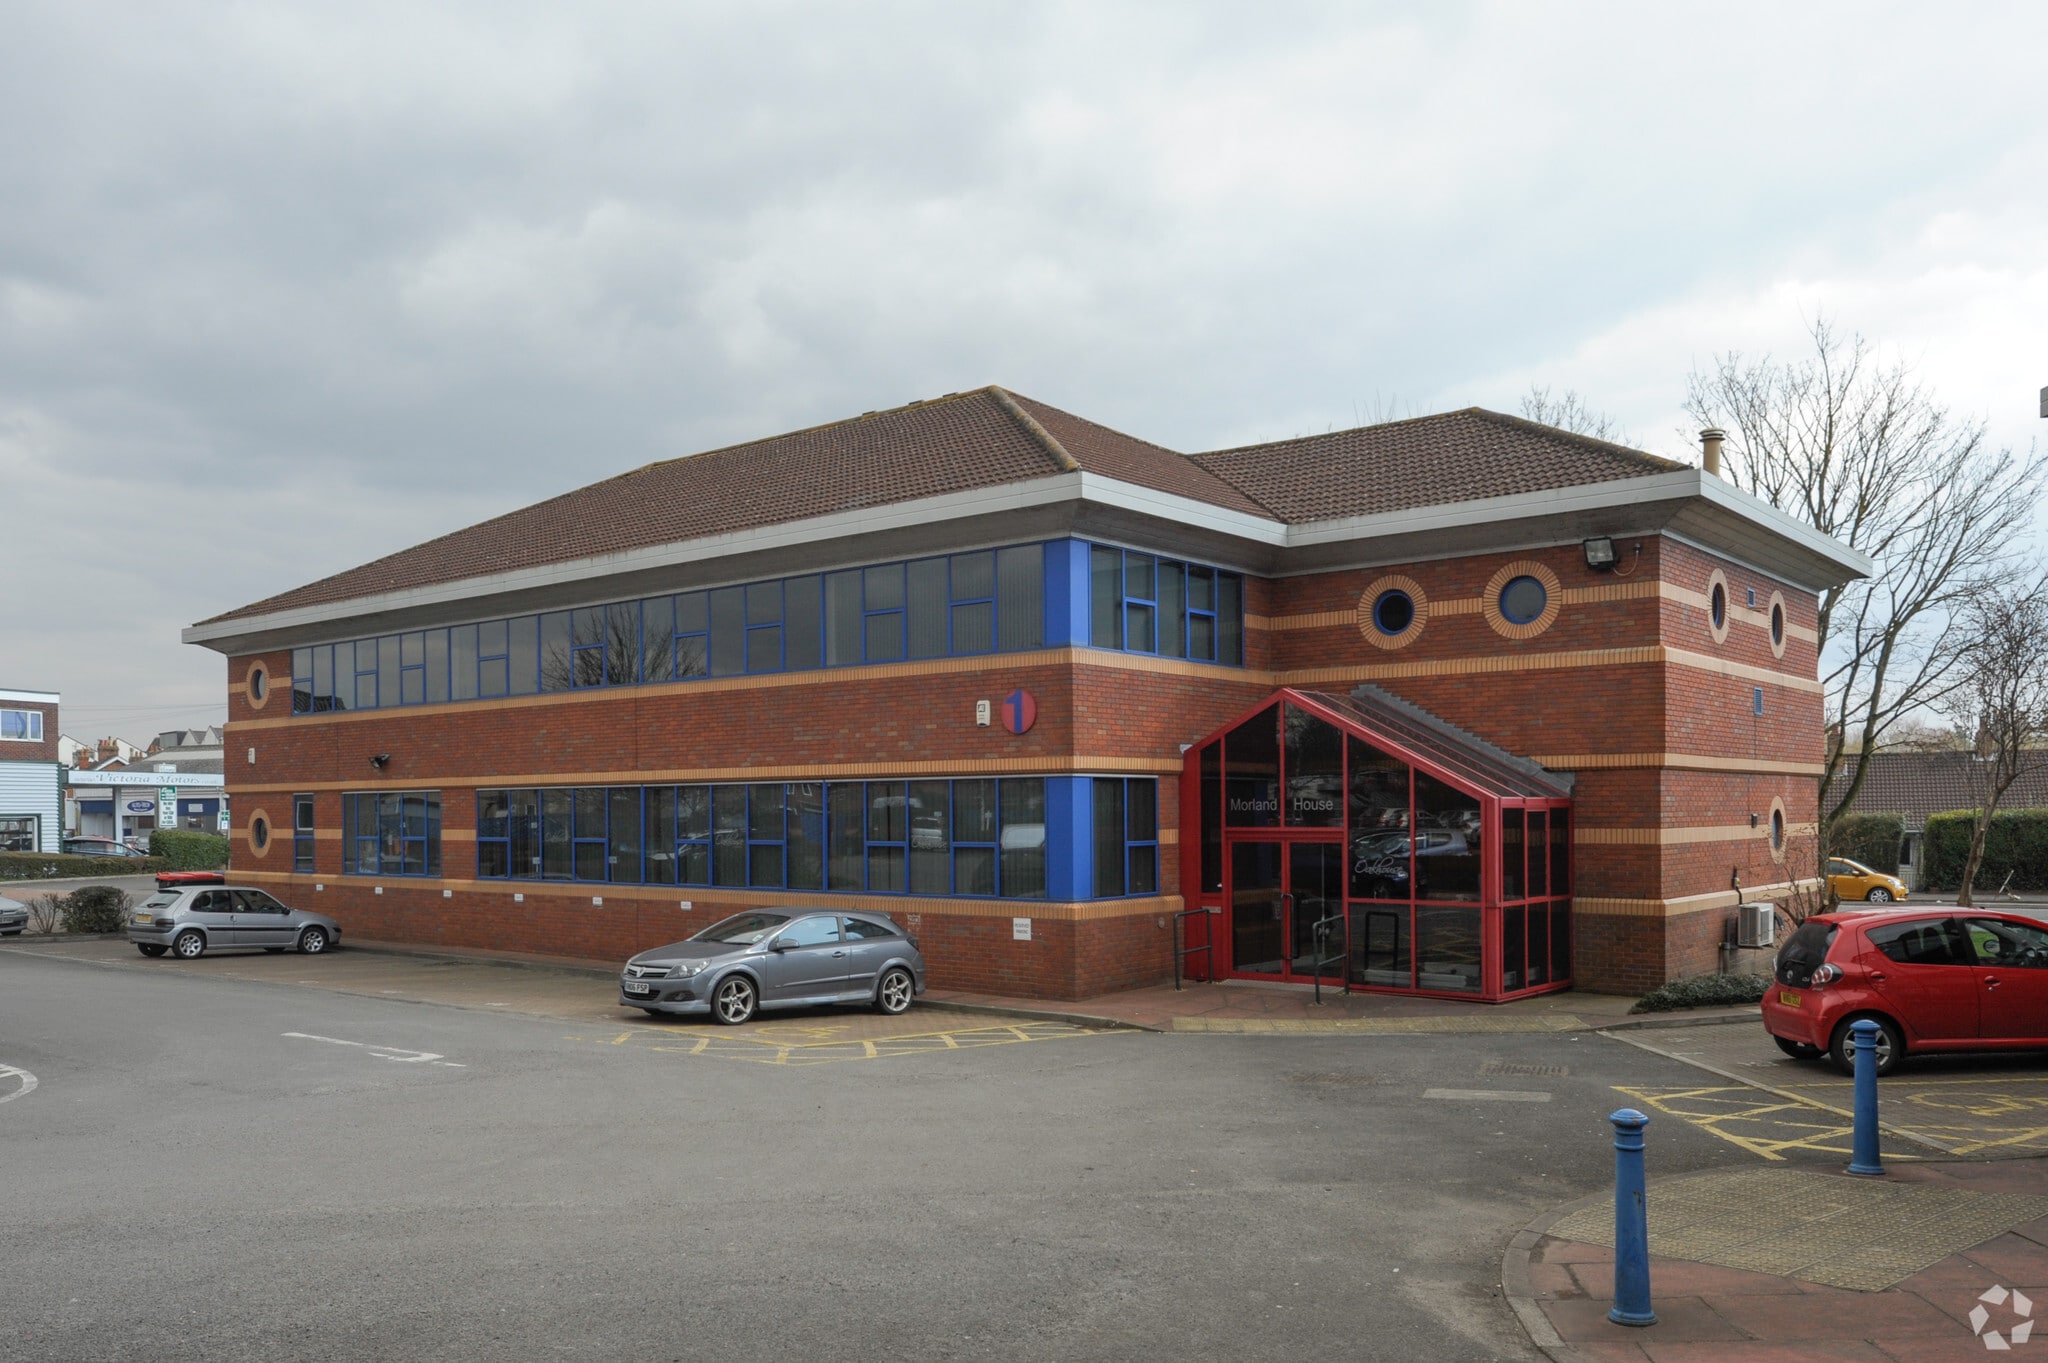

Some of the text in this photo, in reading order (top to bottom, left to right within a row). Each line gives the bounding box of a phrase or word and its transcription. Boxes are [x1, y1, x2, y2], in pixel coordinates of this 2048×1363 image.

[1004, 689, 1023, 734] 1
[96, 773, 150, 783] Victoria
[156, 775, 200, 784] Motors
[1230, 798, 1334, 811] Morland House
